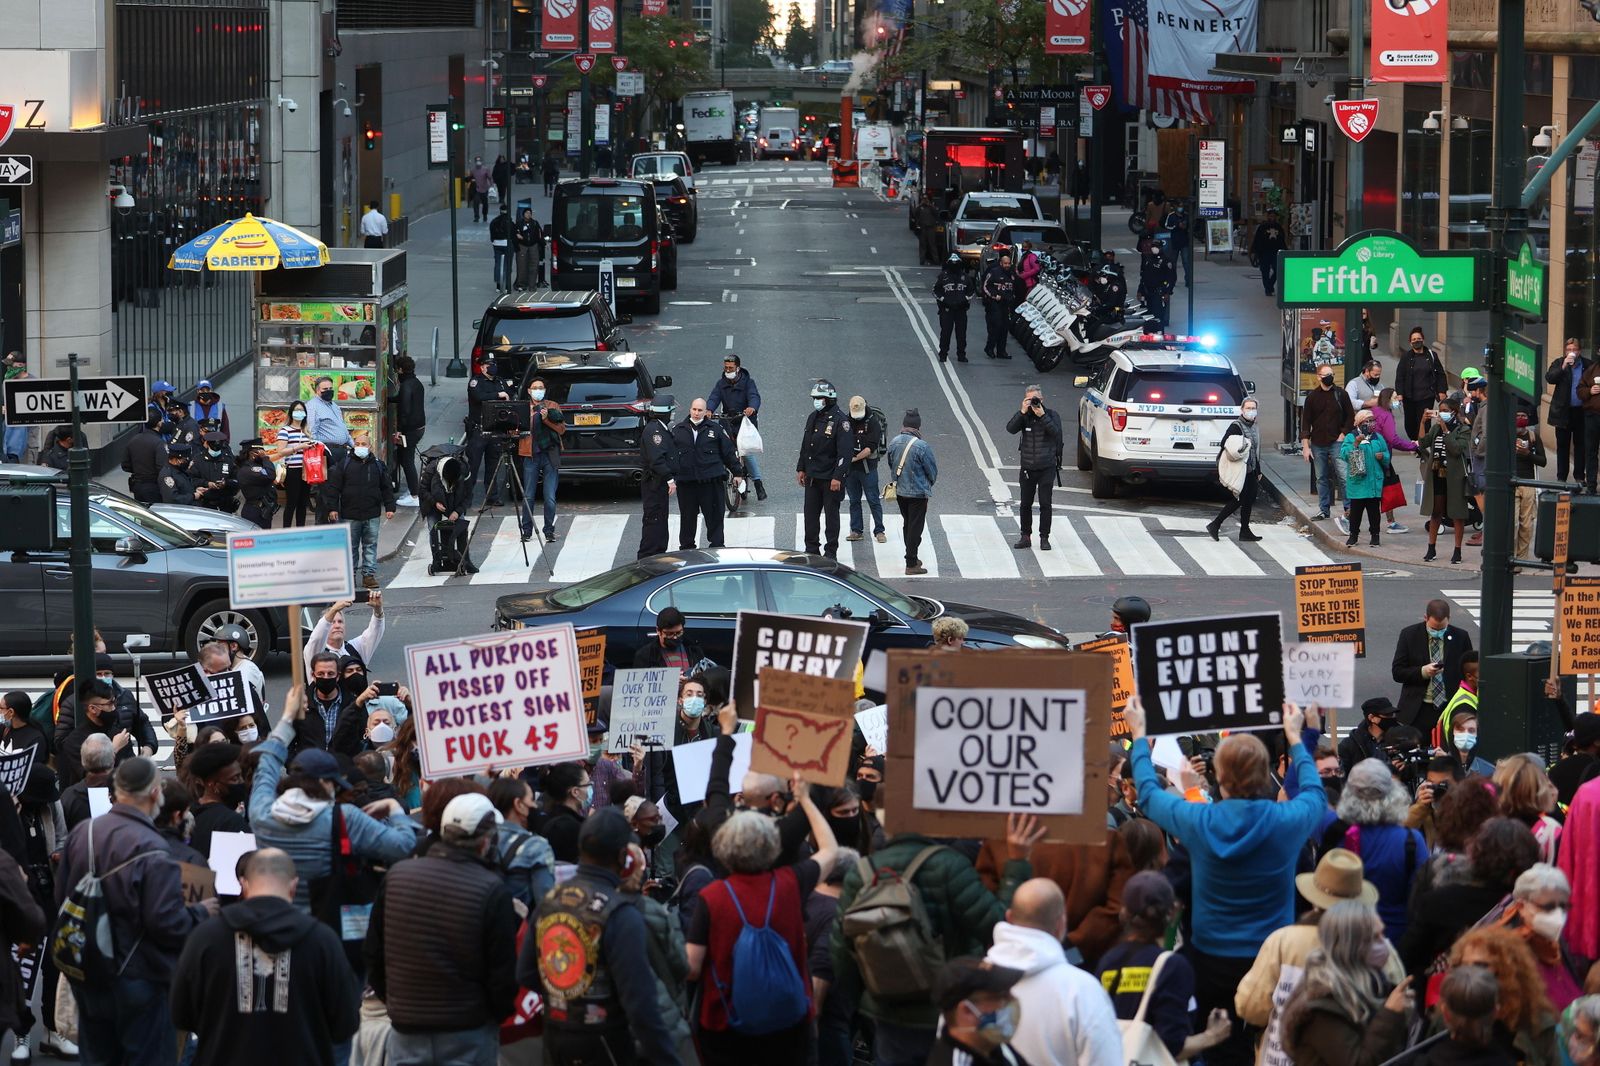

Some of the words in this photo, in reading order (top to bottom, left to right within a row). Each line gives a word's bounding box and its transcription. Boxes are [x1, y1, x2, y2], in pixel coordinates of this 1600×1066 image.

[1157, 11, 1244, 34] RENNERT
[1181, 83, 1223, 91] RENNERT.COM
[692, 107, 725, 119] FedEx
[1339, 104, 1361, 115] Library
[1361, 103, 1376, 113] Way
[222, 233, 265, 245] SABRETT
[211, 255, 276, 267] SABRETT
[1373, 252, 1395, 262] Library
[1311, 266, 1377, 294] Fifth
[1387, 267, 1445, 295] Ave
[1510, 269, 1524, 300] West
[1533, 280, 1541, 306] St
[26, 394, 66, 412] ONE
[84, 392, 124, 410] WAY
[1138, 405, 1165, 413] NYPD
[1201, 406, 1235, 416] POLICE
[1299, 578, 1326, 591] STOP
[1328, 577, 1359, 590] Trump
[1335, 587, 1359, 595] Election!
[1564, 592, 1574, 602] In
[1577, 591, 1594, 602] the
[1300, 601, 1326, 613] TAKE
[1328, 600, 1341, 611] TO
[1342, 599, 1360, 610] THE
[1563, 606, 1574, 615] of
[1301, 610, 1360, 627] STREETS!
[1566, 619, 1582, 629] We
[757, 626, 849, 657] COUNT
[1155, 629, 1260, 659] COUNT
[1571, 633, 1581, 643] to
[425, 652, 463, 676] ALL
[469, 638, 560, 670] PURPOSE
[583, 665, 600, 678] THE
[626, 671, 637, 682] IT
[642, 670, 667, 682] AIN'T
[1157, 653, 1260, 687] EVERY
[154, 672, 191, 688] COUNT
[438, 674, 501, 702] PISSED
[515, 667, 551, 691] OFF
[157, 680, 195, 698] EVERY
[622, 683, 644, 695] OVER
[1301, 683, 1342, 699] VOTE
[162, 690, 202, 709] VOTE
[196, 697, 239, 716] VOTE
[623, 696, 640, 708] IT'S
[644, 696, 668, 708] OVER
[1158, 682, 1264, 721] VOTE
[426, 699, 514, 741] PROTEST
[523, 691, 571, 718] SIGN
[931, 696, 1079, 732] COUNT
[620, 721, 658, 732] COUNT
[445, 729, 514, 764] FUCK
[525, 722, 560, 753] 45
[959, 733, 1040, 771] OUR
[0, 765, 26, 783] VERY
[927, 767, 1055, 808] VOTES
